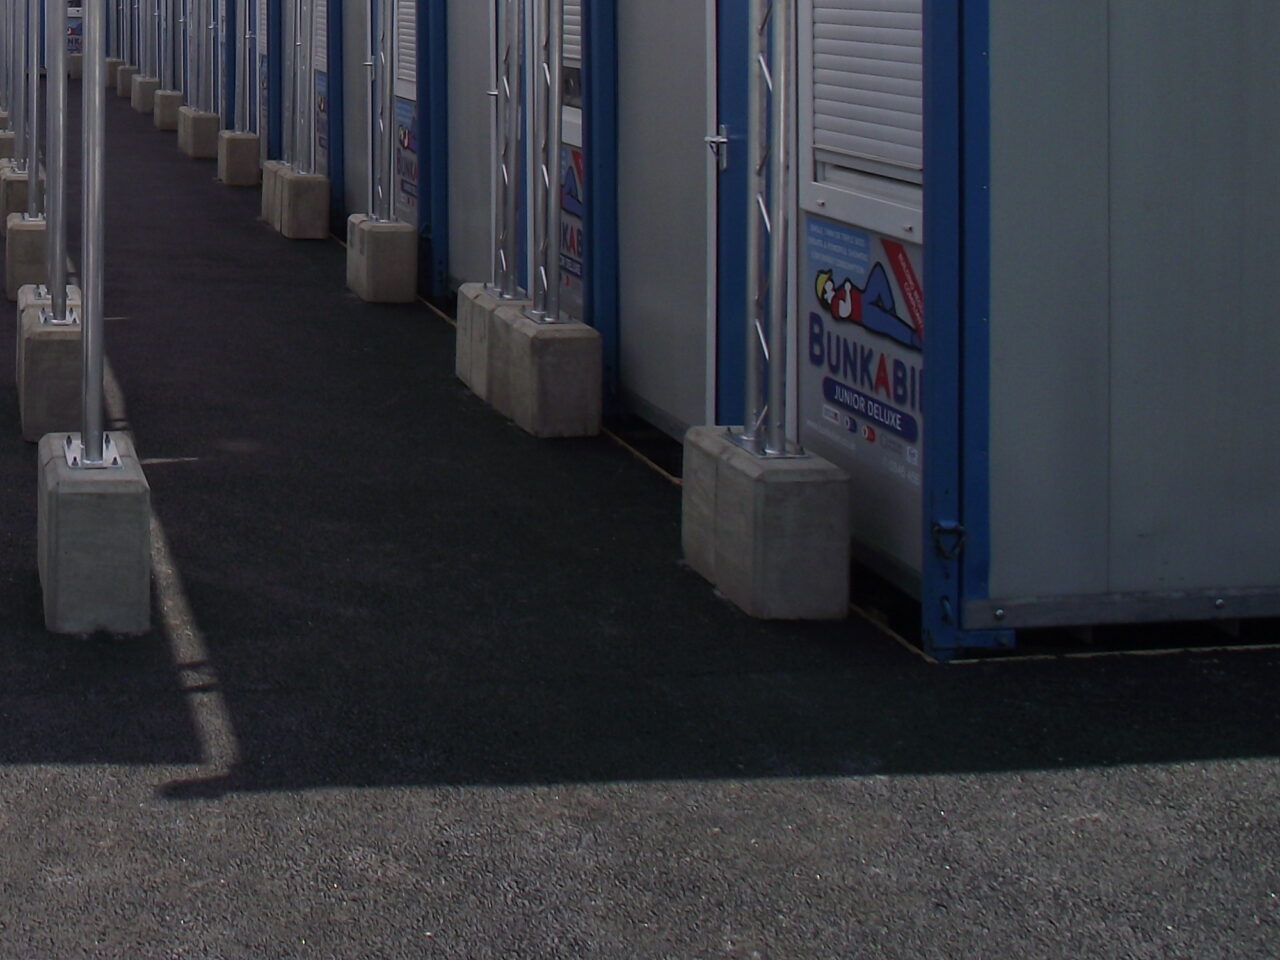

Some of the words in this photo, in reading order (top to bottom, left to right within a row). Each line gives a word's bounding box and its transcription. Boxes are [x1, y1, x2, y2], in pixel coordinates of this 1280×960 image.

[808, 310, 924, 414] BUNKABI
[834, 384, 866, 412] JUNIOR
[867, 400, 902, 431] DELUXE
